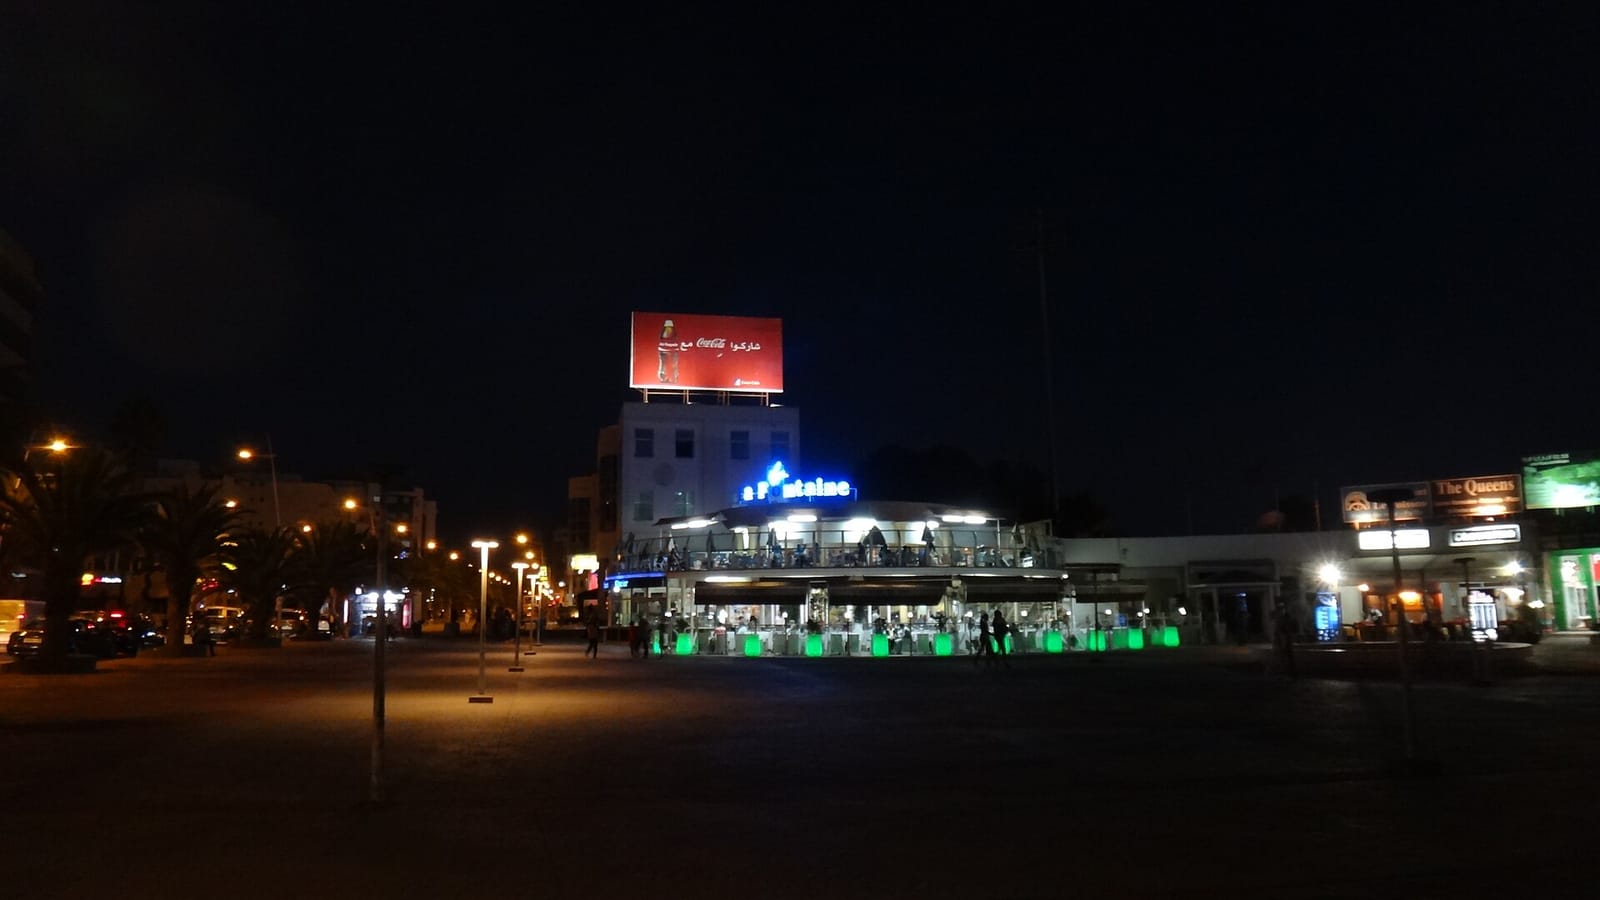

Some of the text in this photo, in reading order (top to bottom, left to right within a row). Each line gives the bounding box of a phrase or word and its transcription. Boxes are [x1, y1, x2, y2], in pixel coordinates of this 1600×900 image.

[680, 342, 693, 352] مع
[730, 342, 761, 352] شاركوا
[1438, 482, 1462, 495] The
[1464, 479, 1515, 496] Queens
